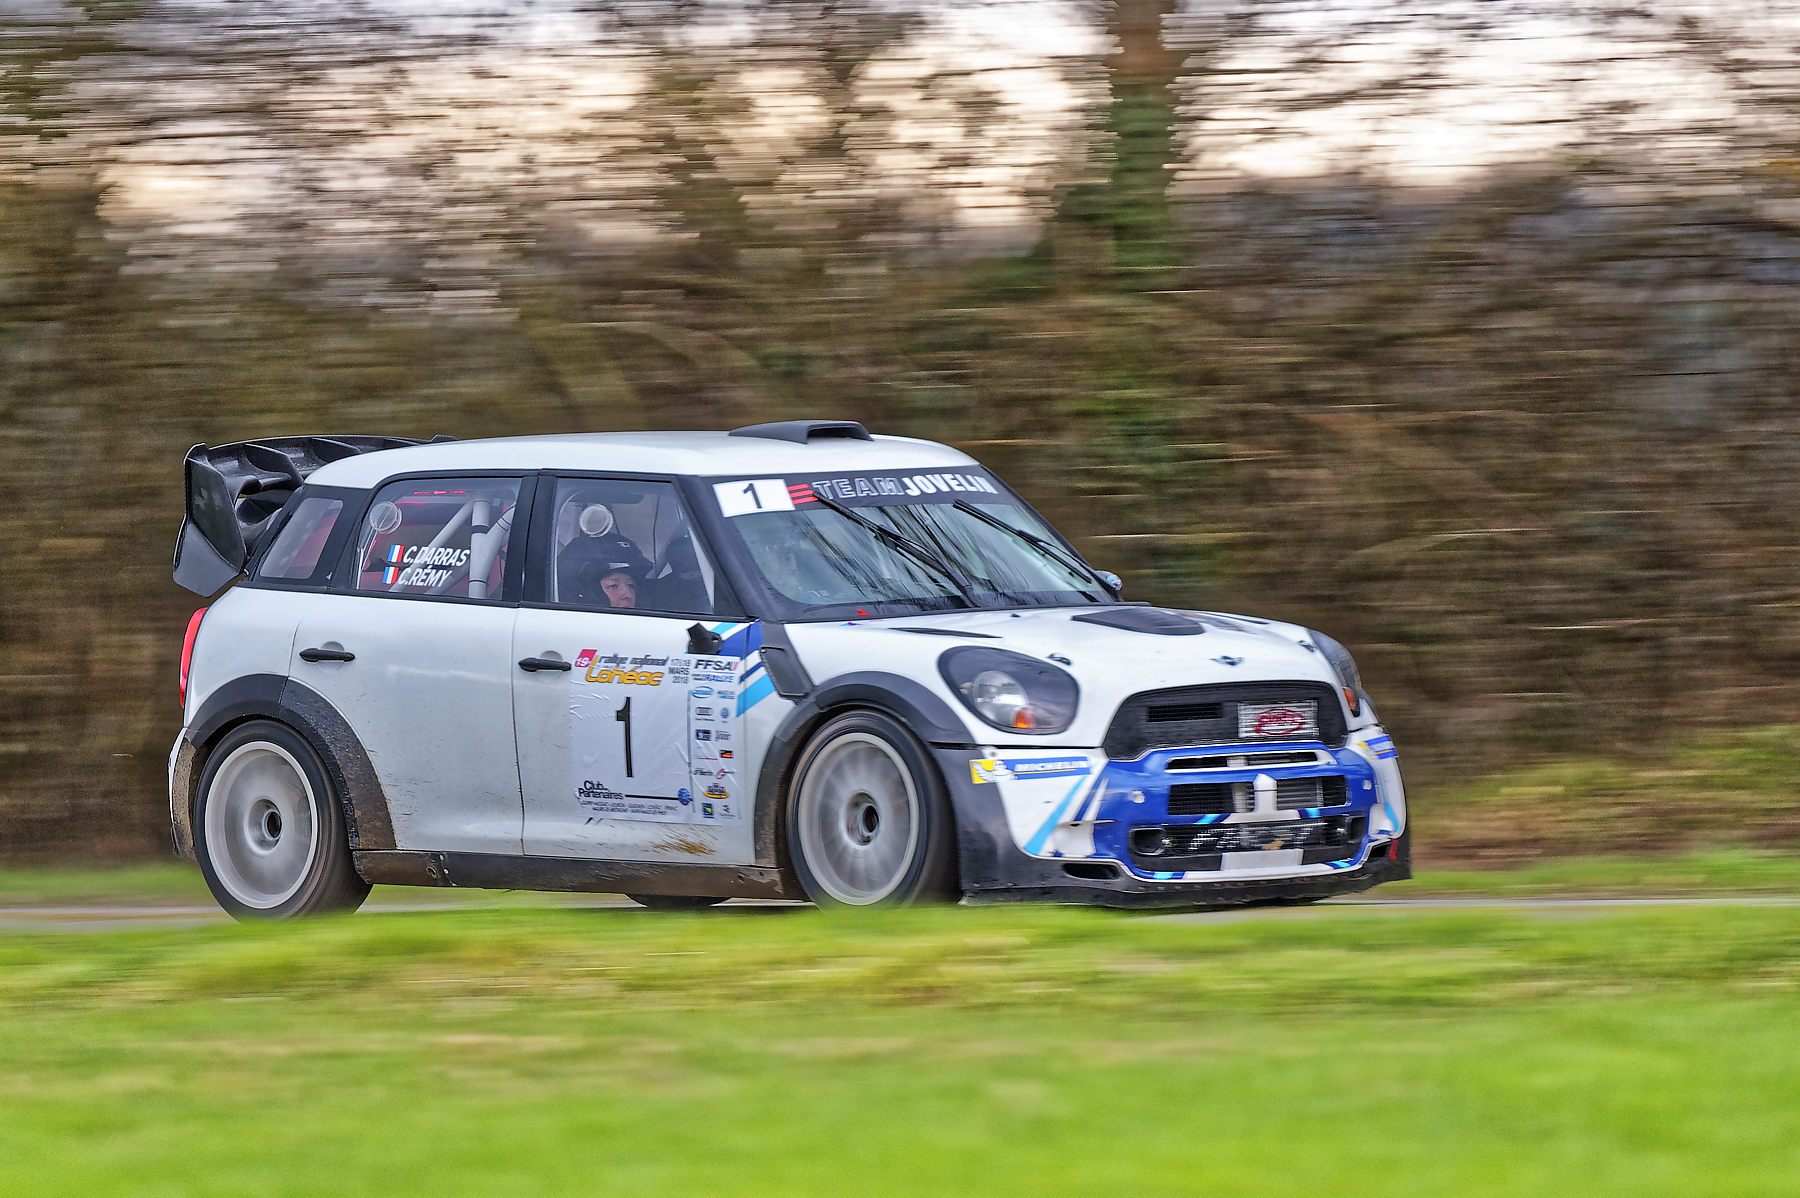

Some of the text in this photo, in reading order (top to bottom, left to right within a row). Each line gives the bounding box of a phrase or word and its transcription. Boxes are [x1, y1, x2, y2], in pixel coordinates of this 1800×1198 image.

[742, 483, 763, 509] 1
[812, 473, 999, 500] TEAM JOVELIN
[402, 545, 471, 567] C.DARRAS
[398, 565, 453, 587] C.RÉMY
[668, 667, 690, 676] MARS
[694, 659, 733, 671] FFSA
[615, 696, 633, 778] 1
[578, 787, 625, 800] Partenaires
[583, 780, 605, 791] Club
